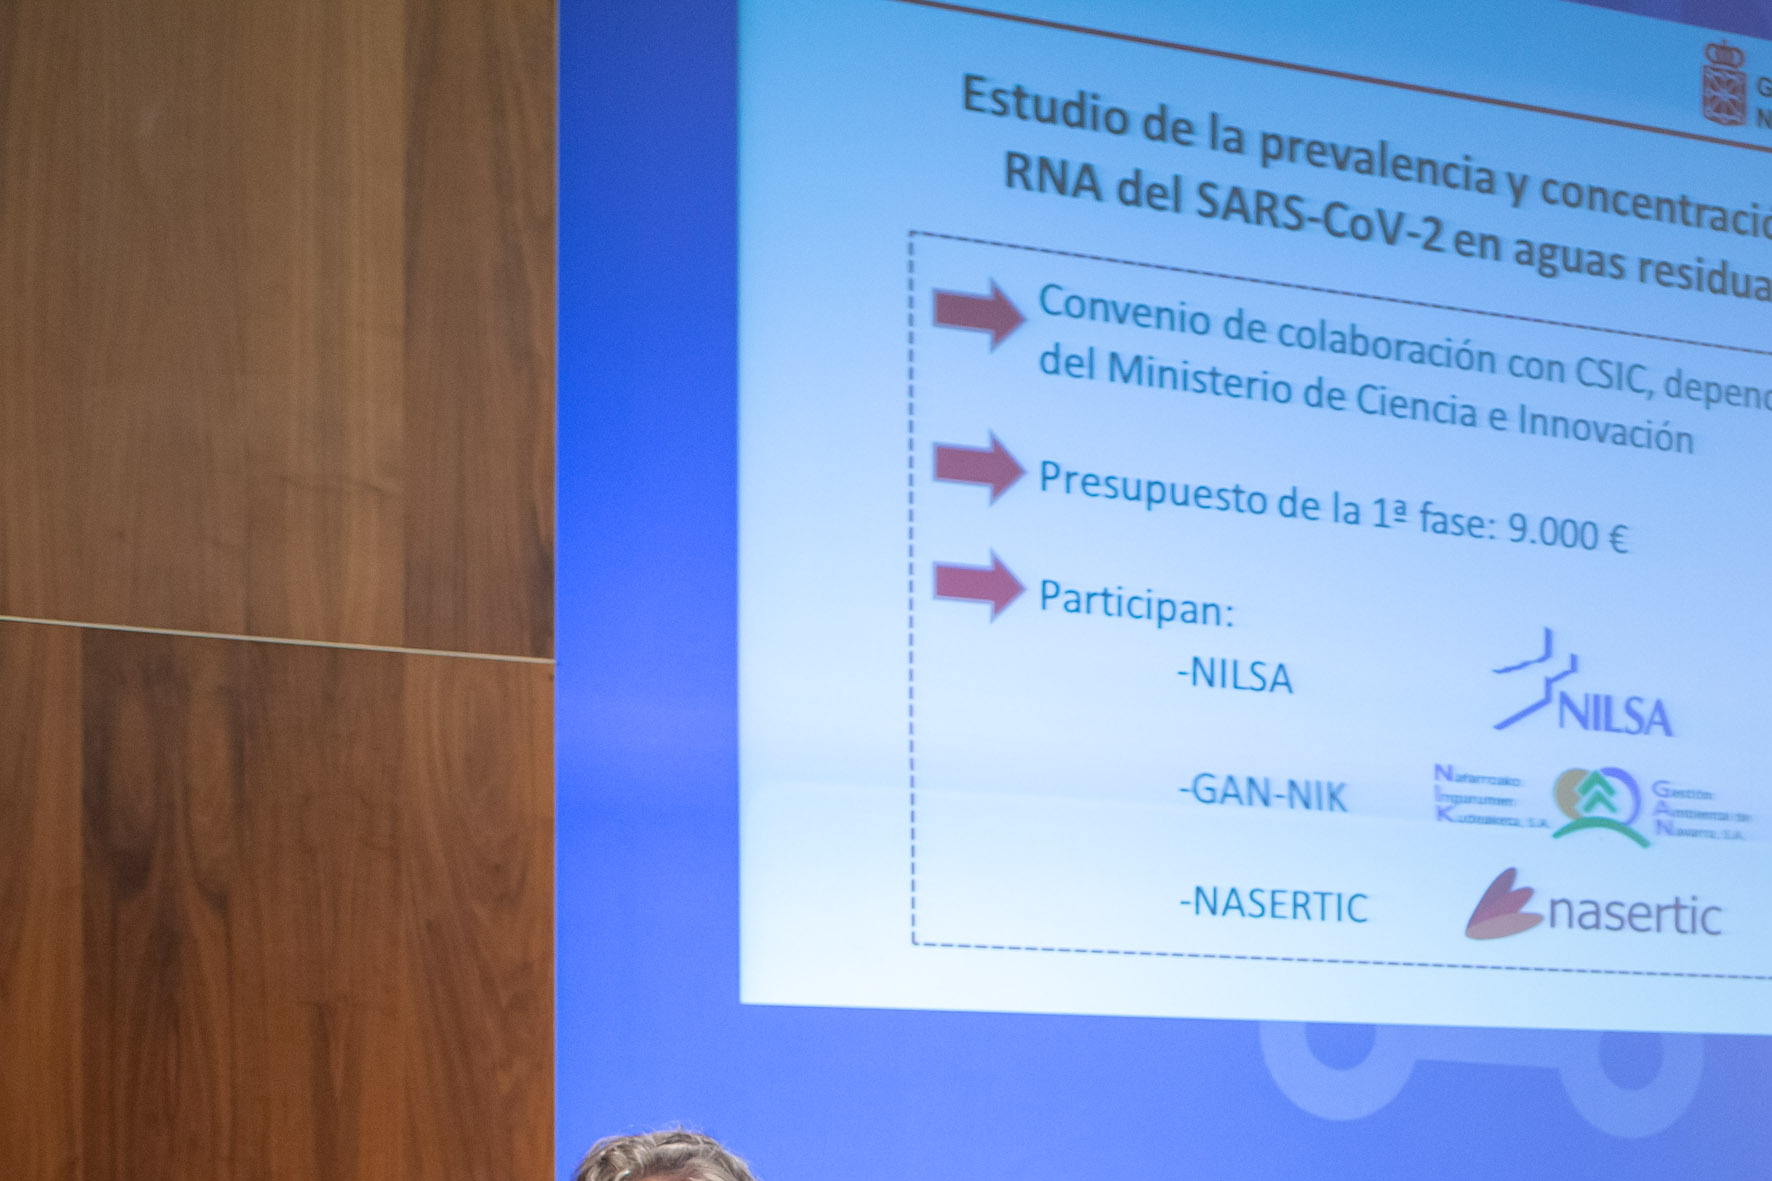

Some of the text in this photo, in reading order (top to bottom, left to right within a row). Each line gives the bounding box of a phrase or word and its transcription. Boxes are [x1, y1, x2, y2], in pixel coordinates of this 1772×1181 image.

[963, 73, 1129, 136] Estudio
[1143, 104, 1194, 146] de
[1209, 112, 1244, 155] la
[1260, 130, 1496, 196] prevalencia
[1507, 171, 1530, 208] y
[1005, 150, 1102, 203] RNA
[1118, 168, 1182, 214] del
[1197, 181, 1445, 254] SARS-CoV-2
[1454, 228, 1502, 262] en
[1515, 237, 1626, 281] aguas
[1039, 283, 1211, 336] Convenio
[1223, 308, 1267, 344] de
[1278, 319, 1497, 375] colaboración
[1508, 353, 1566, 384] con
[1575, 357, 1655, 400] CSIC,
[1039, 343, 1695, 455] del Ministerio de Ciencia e Innovación
[1040, 460, 1630, 554] Presupuesto de la 1ª fase: 9.000 €
[1040, 579, 1234, 629] Participan:
[1177, 656, 1294, 695] -NILSA
[1558, 690, 1675, 737] NILSA
[1179, 772, 1348, 813] -GAN-NIK
[1180, 885, 1369, 923] -NASERTIC
[1550, 895, 1722, 936] nasertic
